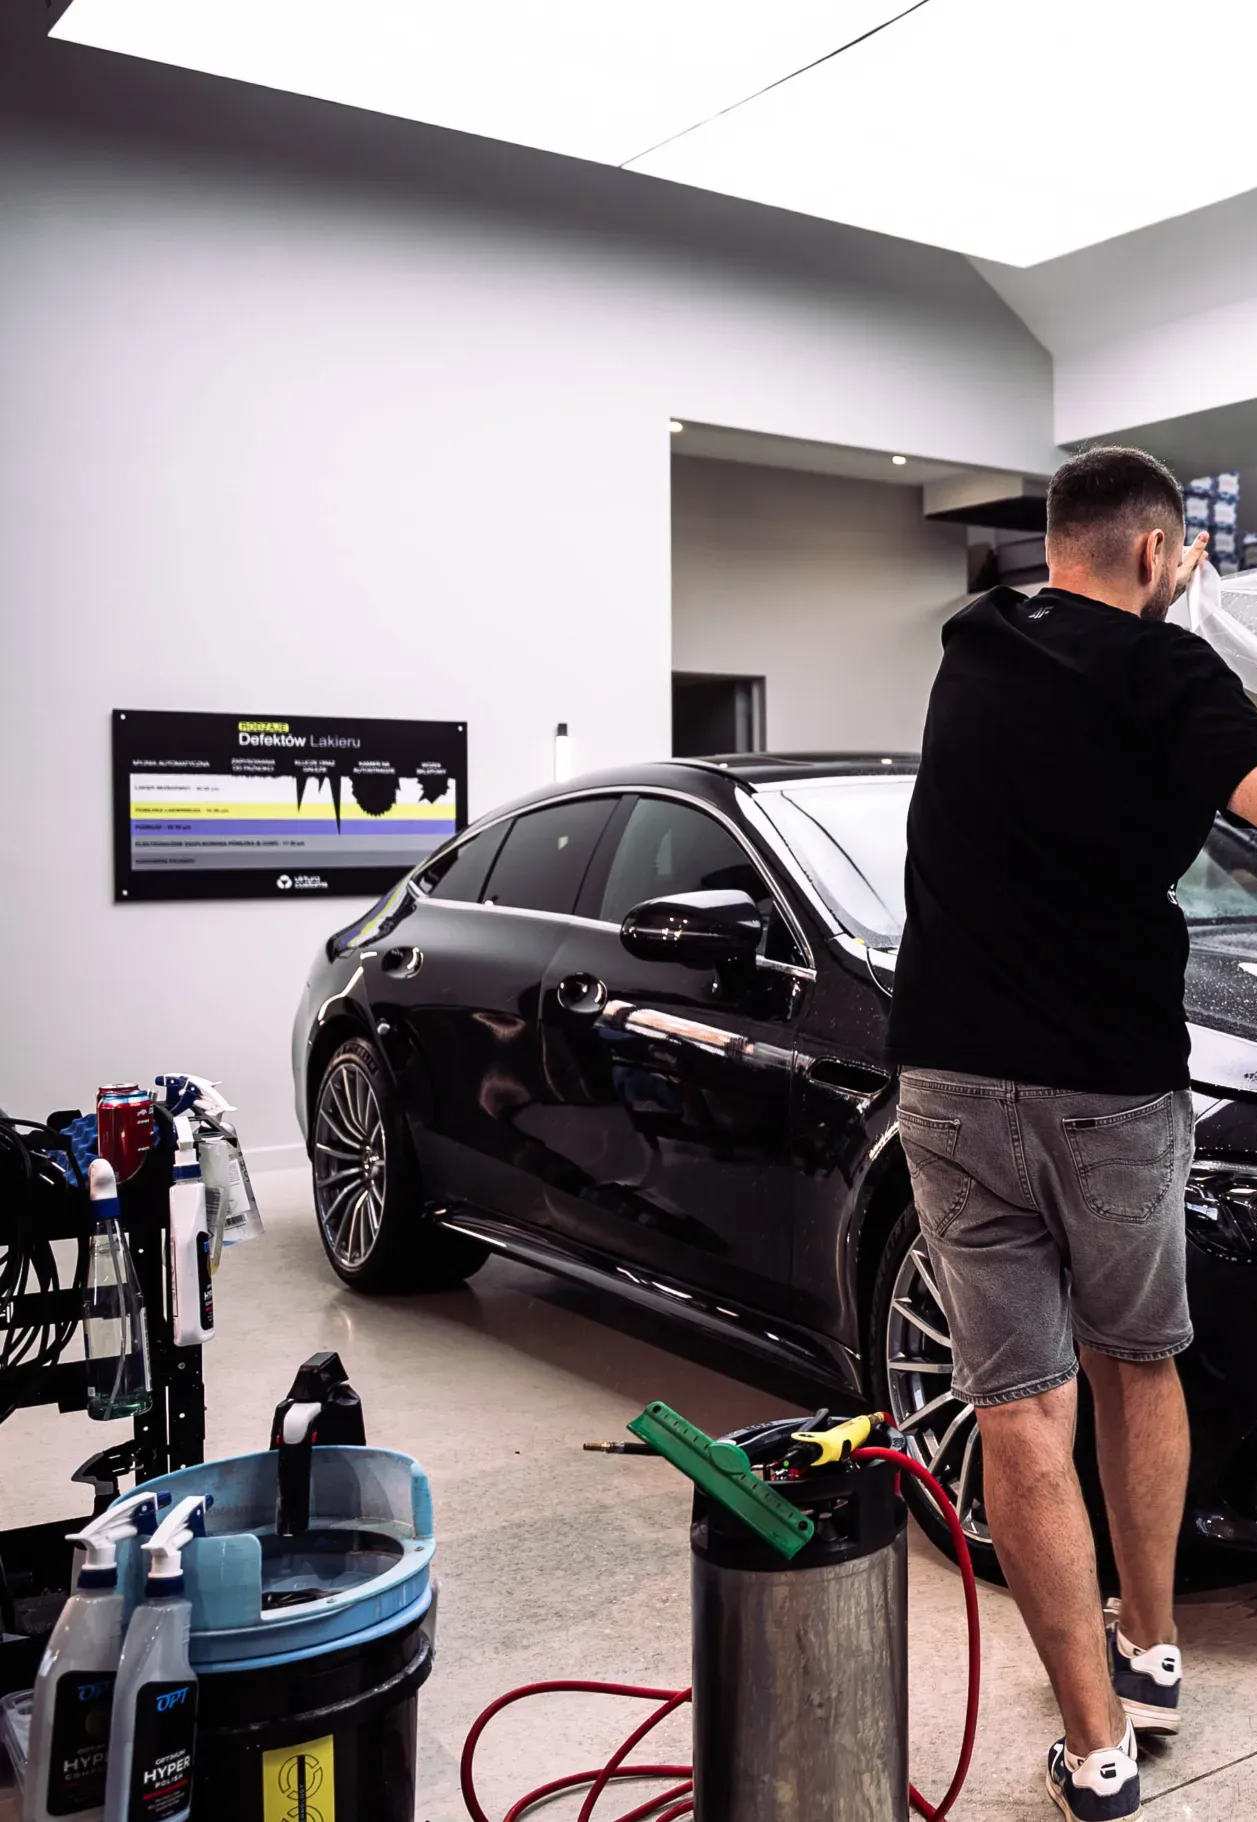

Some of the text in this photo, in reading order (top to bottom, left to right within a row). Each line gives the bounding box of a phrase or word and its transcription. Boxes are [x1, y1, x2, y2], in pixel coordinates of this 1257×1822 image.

[241, 722, 287, 732] RODZAJE
[239, 733, 361, 748] Defektów Lakieru
[156, 1687, 189, 1712] OPT
[63, 1752, 109, 1773] HYP
[143, 1755, 190, 1784] HYPER
[154, 1773, 183, 1789] POLISH
